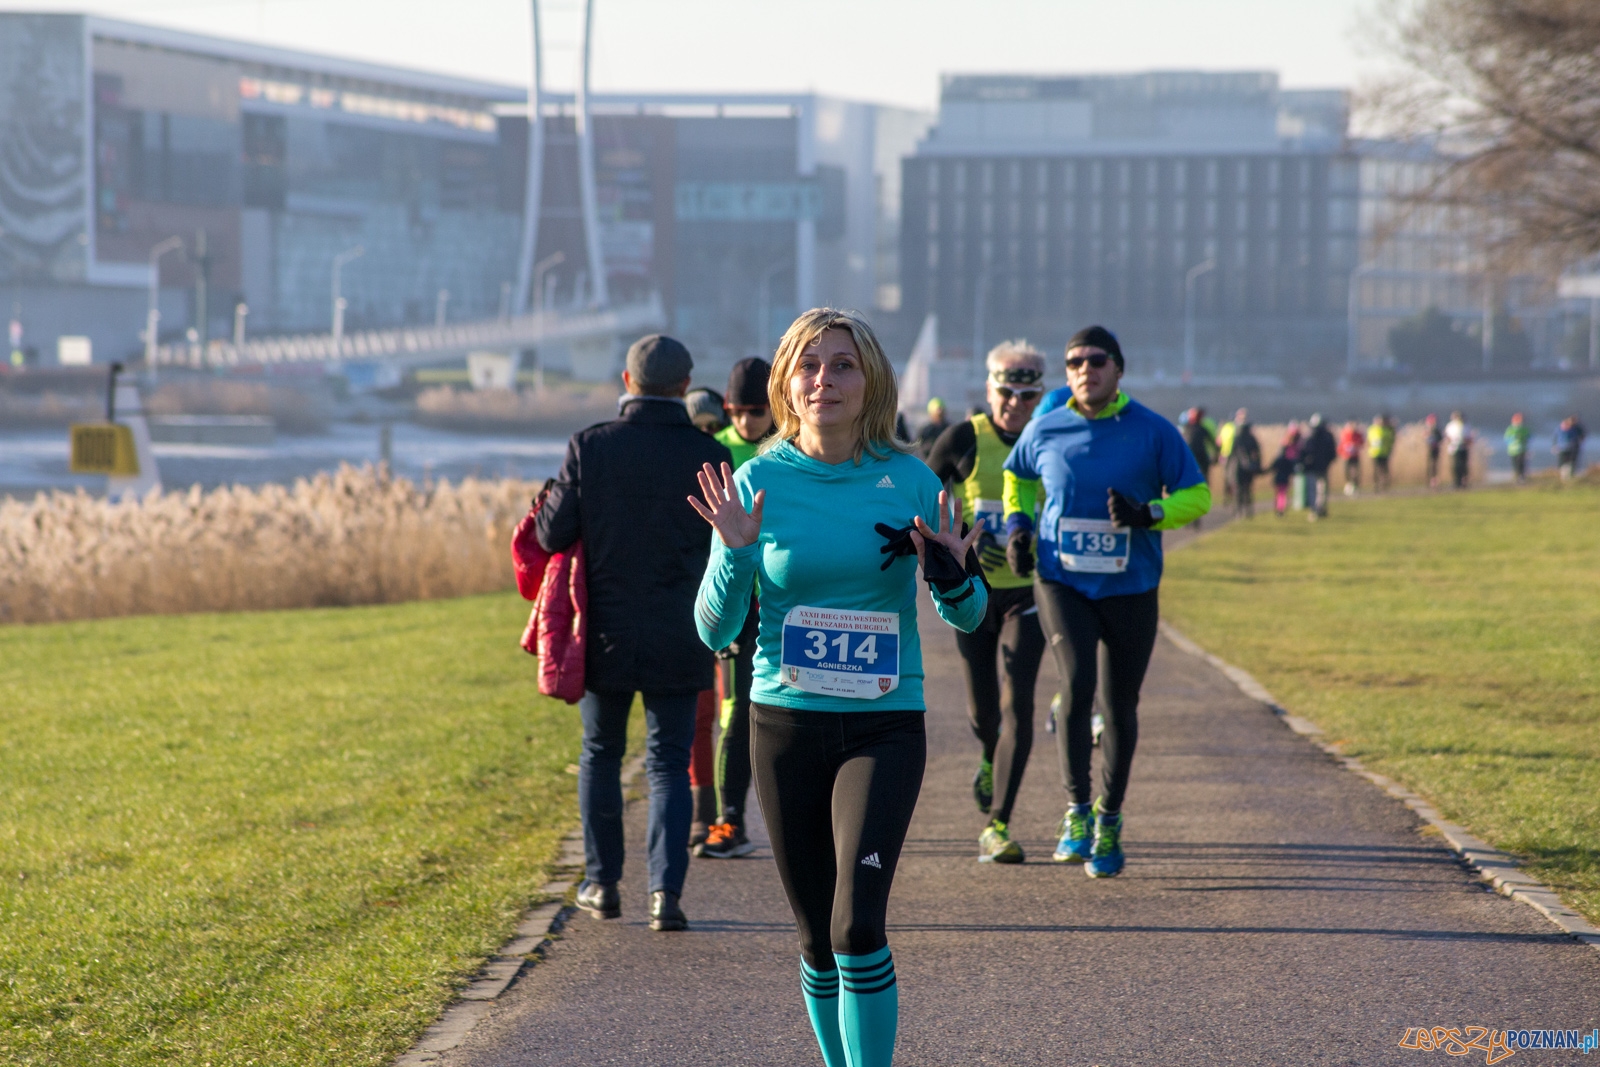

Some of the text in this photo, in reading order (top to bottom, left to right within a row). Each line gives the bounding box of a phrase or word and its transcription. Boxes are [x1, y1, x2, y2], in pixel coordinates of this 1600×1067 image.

[1072, 534, 1116, 552] 139
[799, 610, 819, 618] XXXII
[821, 612, 838, 620] BIEG
[840, 614, 892, 623] SYLWESTROWY
[814, 620, 853, 630] RYSZARDA
[804, 630, 878, 664] 314
[817, 662, 863, 671] AGNIESZKA
[861, 859, 882, 869] adidas
